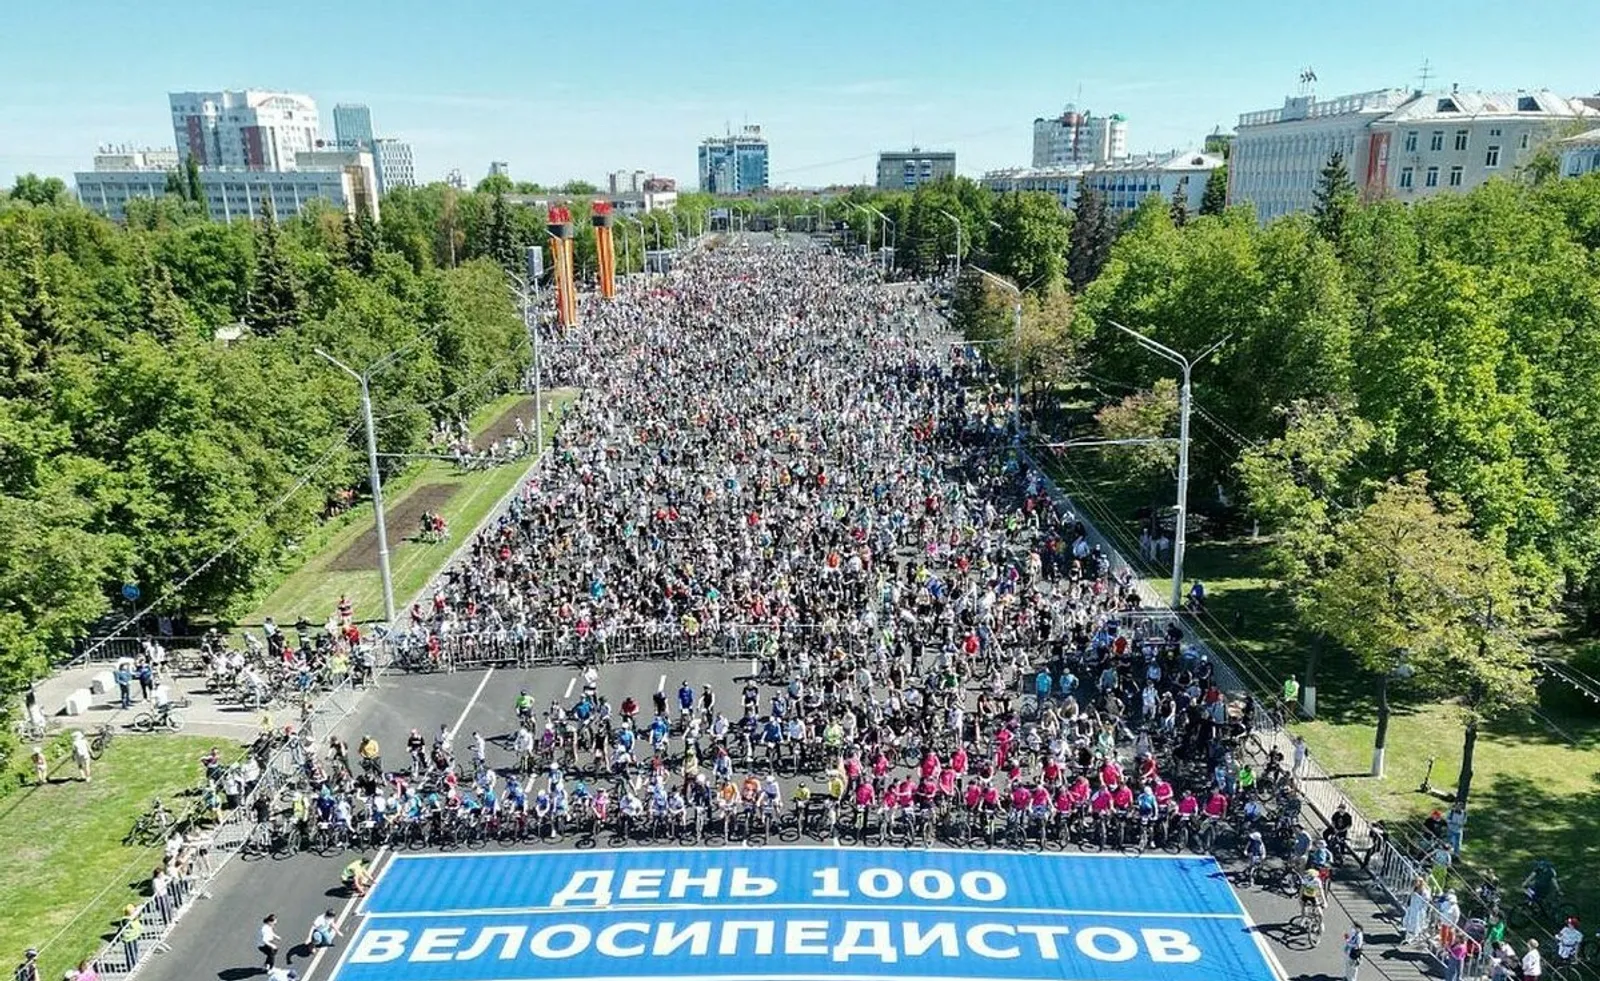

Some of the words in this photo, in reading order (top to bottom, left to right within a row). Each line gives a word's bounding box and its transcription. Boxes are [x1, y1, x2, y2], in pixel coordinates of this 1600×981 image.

[550, 868, 778, 907] ДЕНЬ
[811, 868, 1007, 900] 1000
[349, 920, 1201, 964] ВЕЛОСИПЕДИСТОВ
